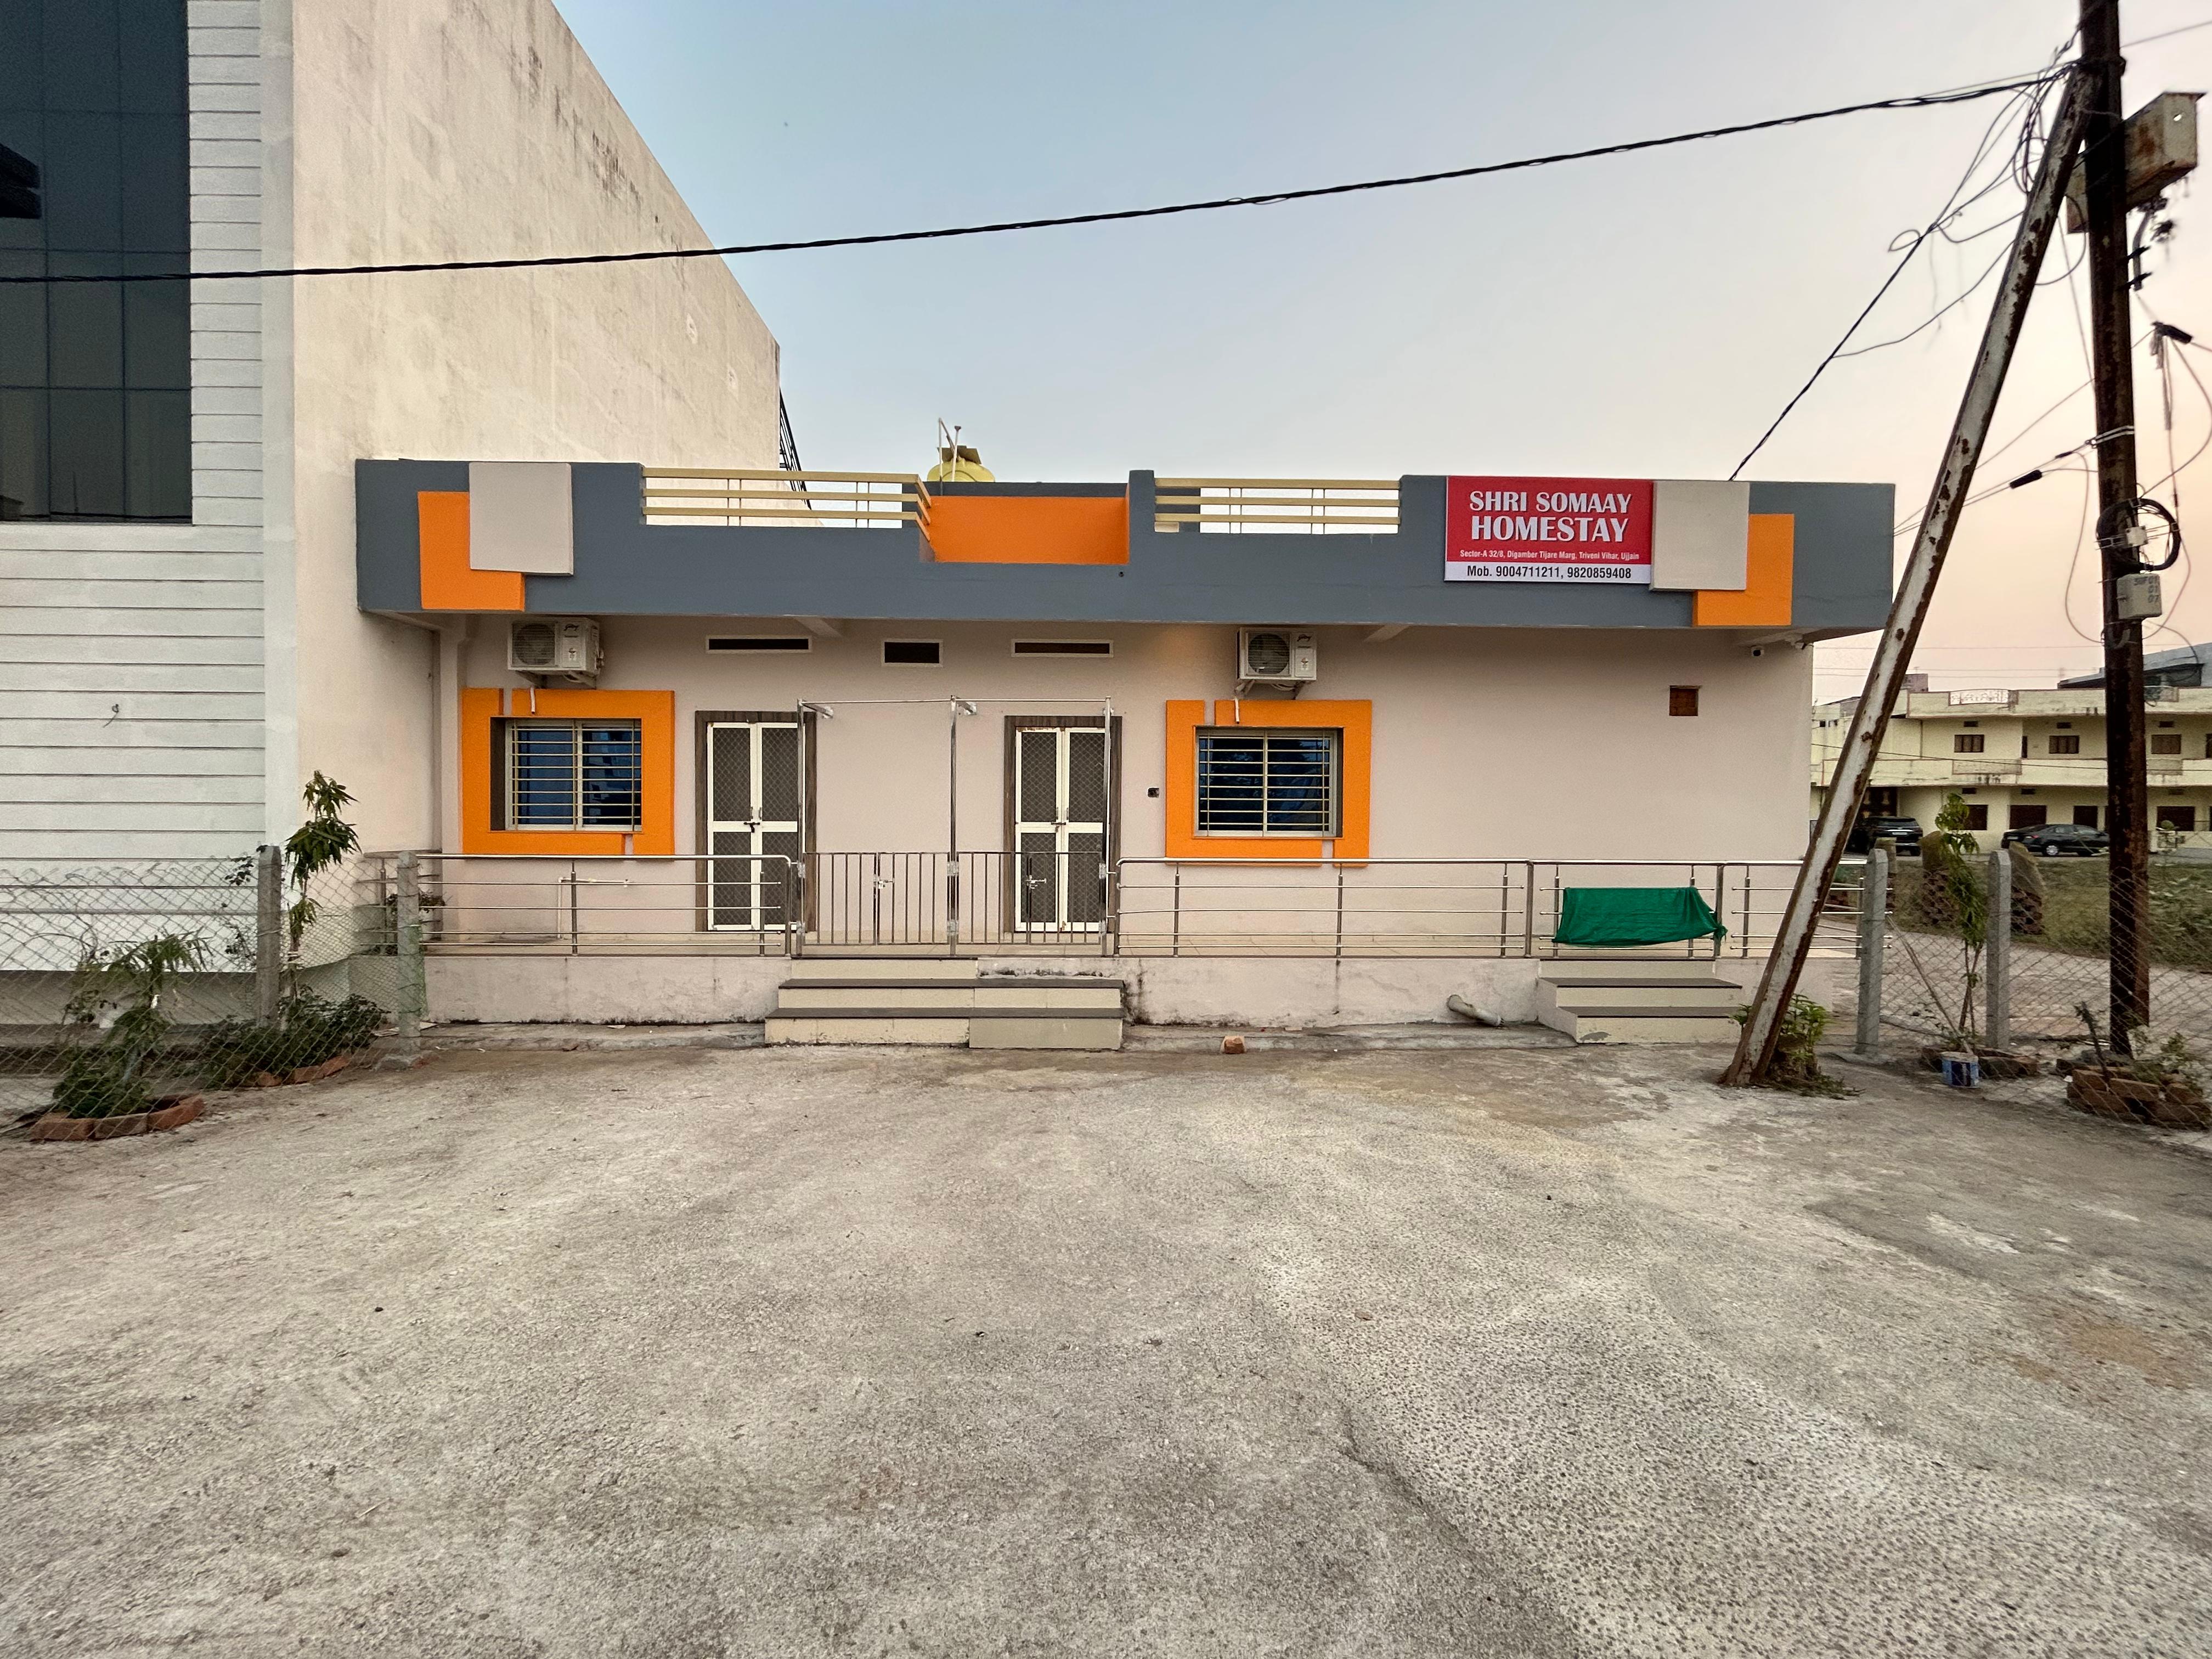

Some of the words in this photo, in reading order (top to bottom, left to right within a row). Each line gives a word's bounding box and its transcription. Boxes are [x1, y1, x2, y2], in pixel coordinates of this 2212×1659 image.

[1470, 491, 1527, 511] SHRI
[1536, 492, 1631, 513] SOMAAY
[1471, 516, 1628, 542] HOMESTAY
[1507, 550, 1538, 559] Digamber
[1539, 551, 1558, 560] Tijare
[1621, 552, 1639, 561] Ujjain
[1467, 566, 1492, 576] Mob.
[1496, 566, 1564, 579] 9004711211,
[1567, 567, 1632, 579] 9820859408
